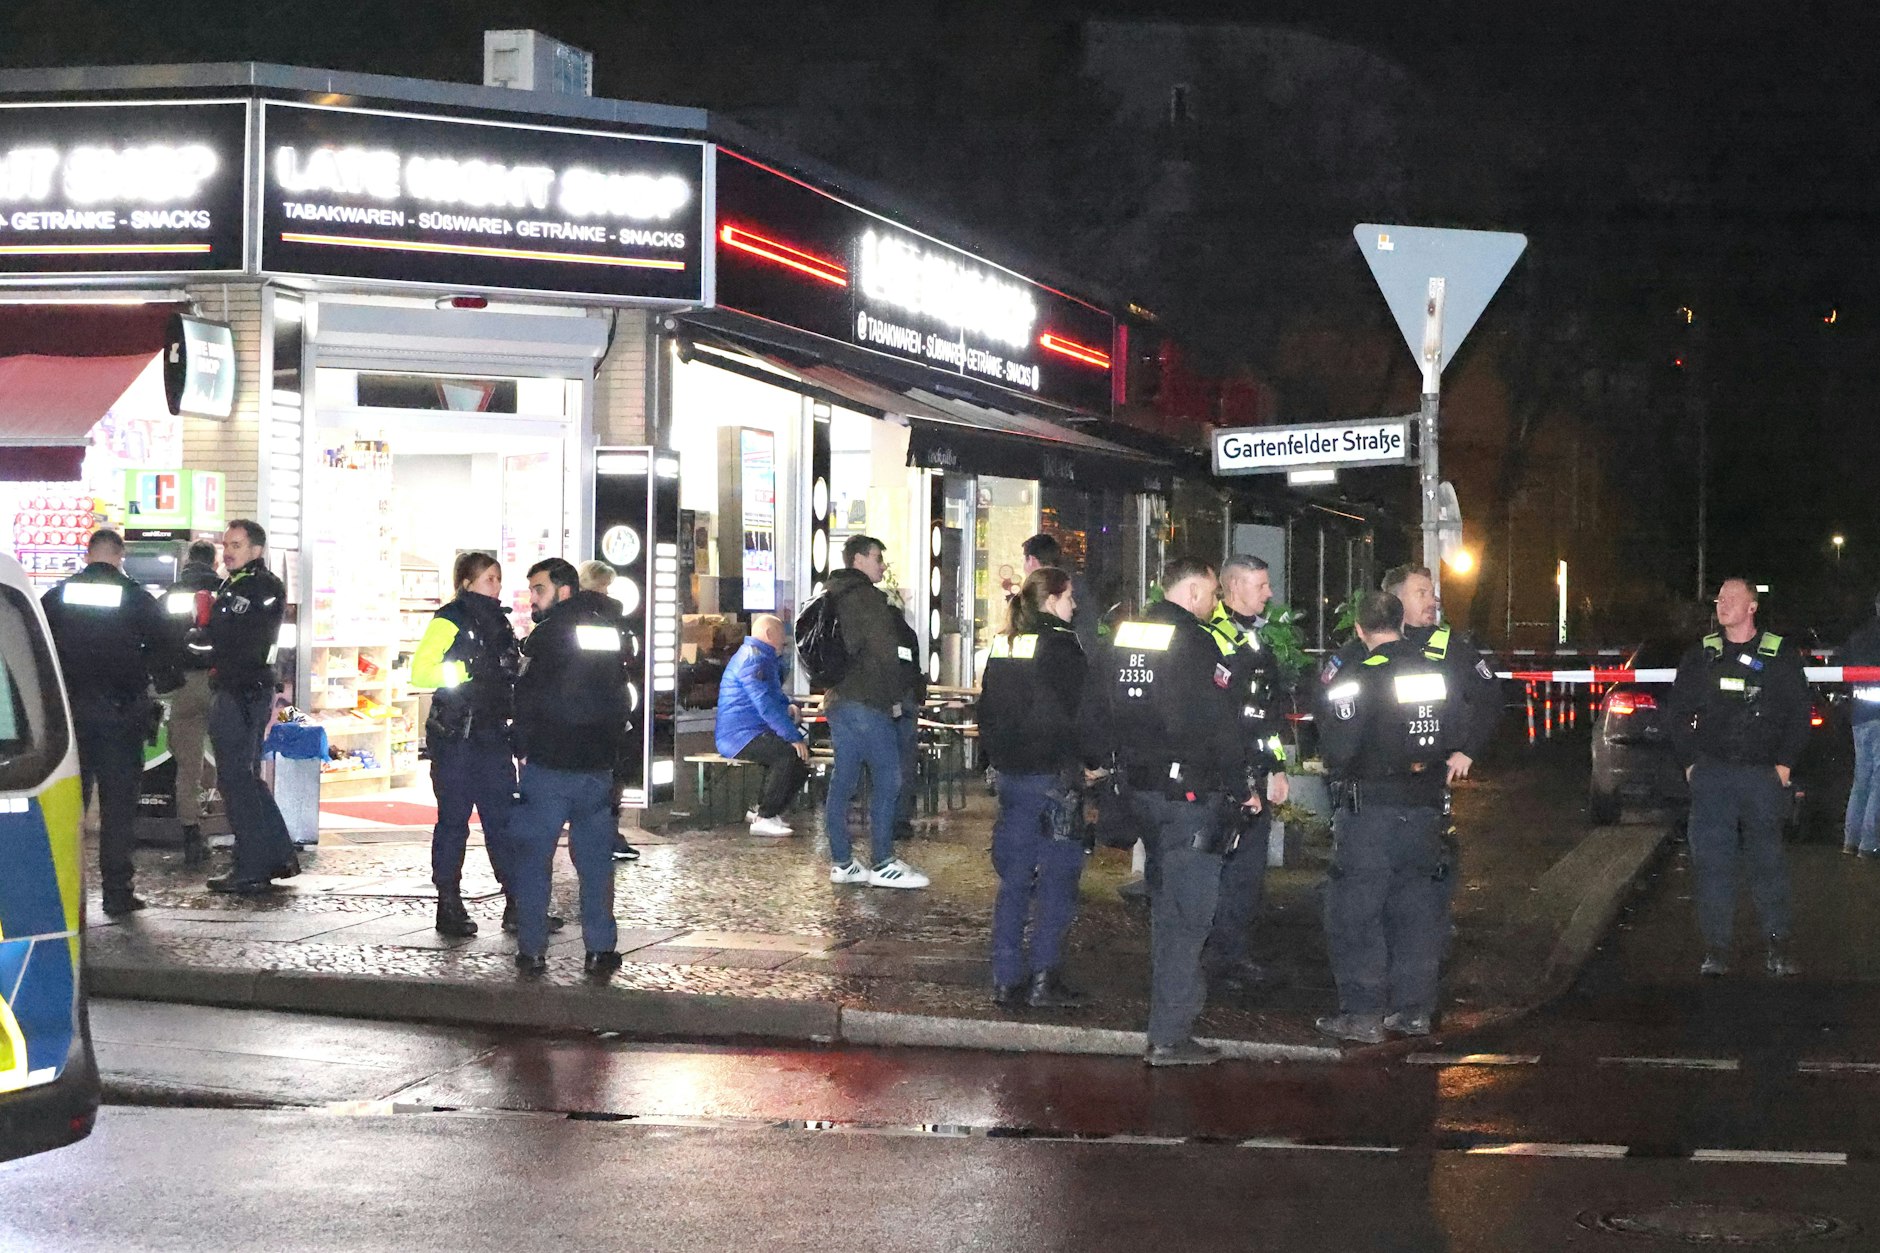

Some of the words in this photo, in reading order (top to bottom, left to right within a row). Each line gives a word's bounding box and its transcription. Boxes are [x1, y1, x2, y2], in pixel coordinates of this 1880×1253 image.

[11, 208, 116, 231] GETRÄNKE
[130, 209, 211, 230] SNACKS
[282, 201, 405, 227] TABAKWAREN
[515, 219, 607, 243] GETRÄNKE
[619, 228, 686, 249] SNACKS
[867, 317, 922, 355] TABAKWAREN
[966, 349, 1003, 379] GETRÄNKE
[1006, 361, 1032, 388] SNACKS
[1223, 431, 1339, 459] Gartenfelder
[1342, 428, 1401, 454] Straße
[1129, 653, 1146, 667] BE
[1119, 668, 1154, 683] 23330
[1418, 705, 1433, 719] BE
[1408, 719, 1440, 734] 23331
